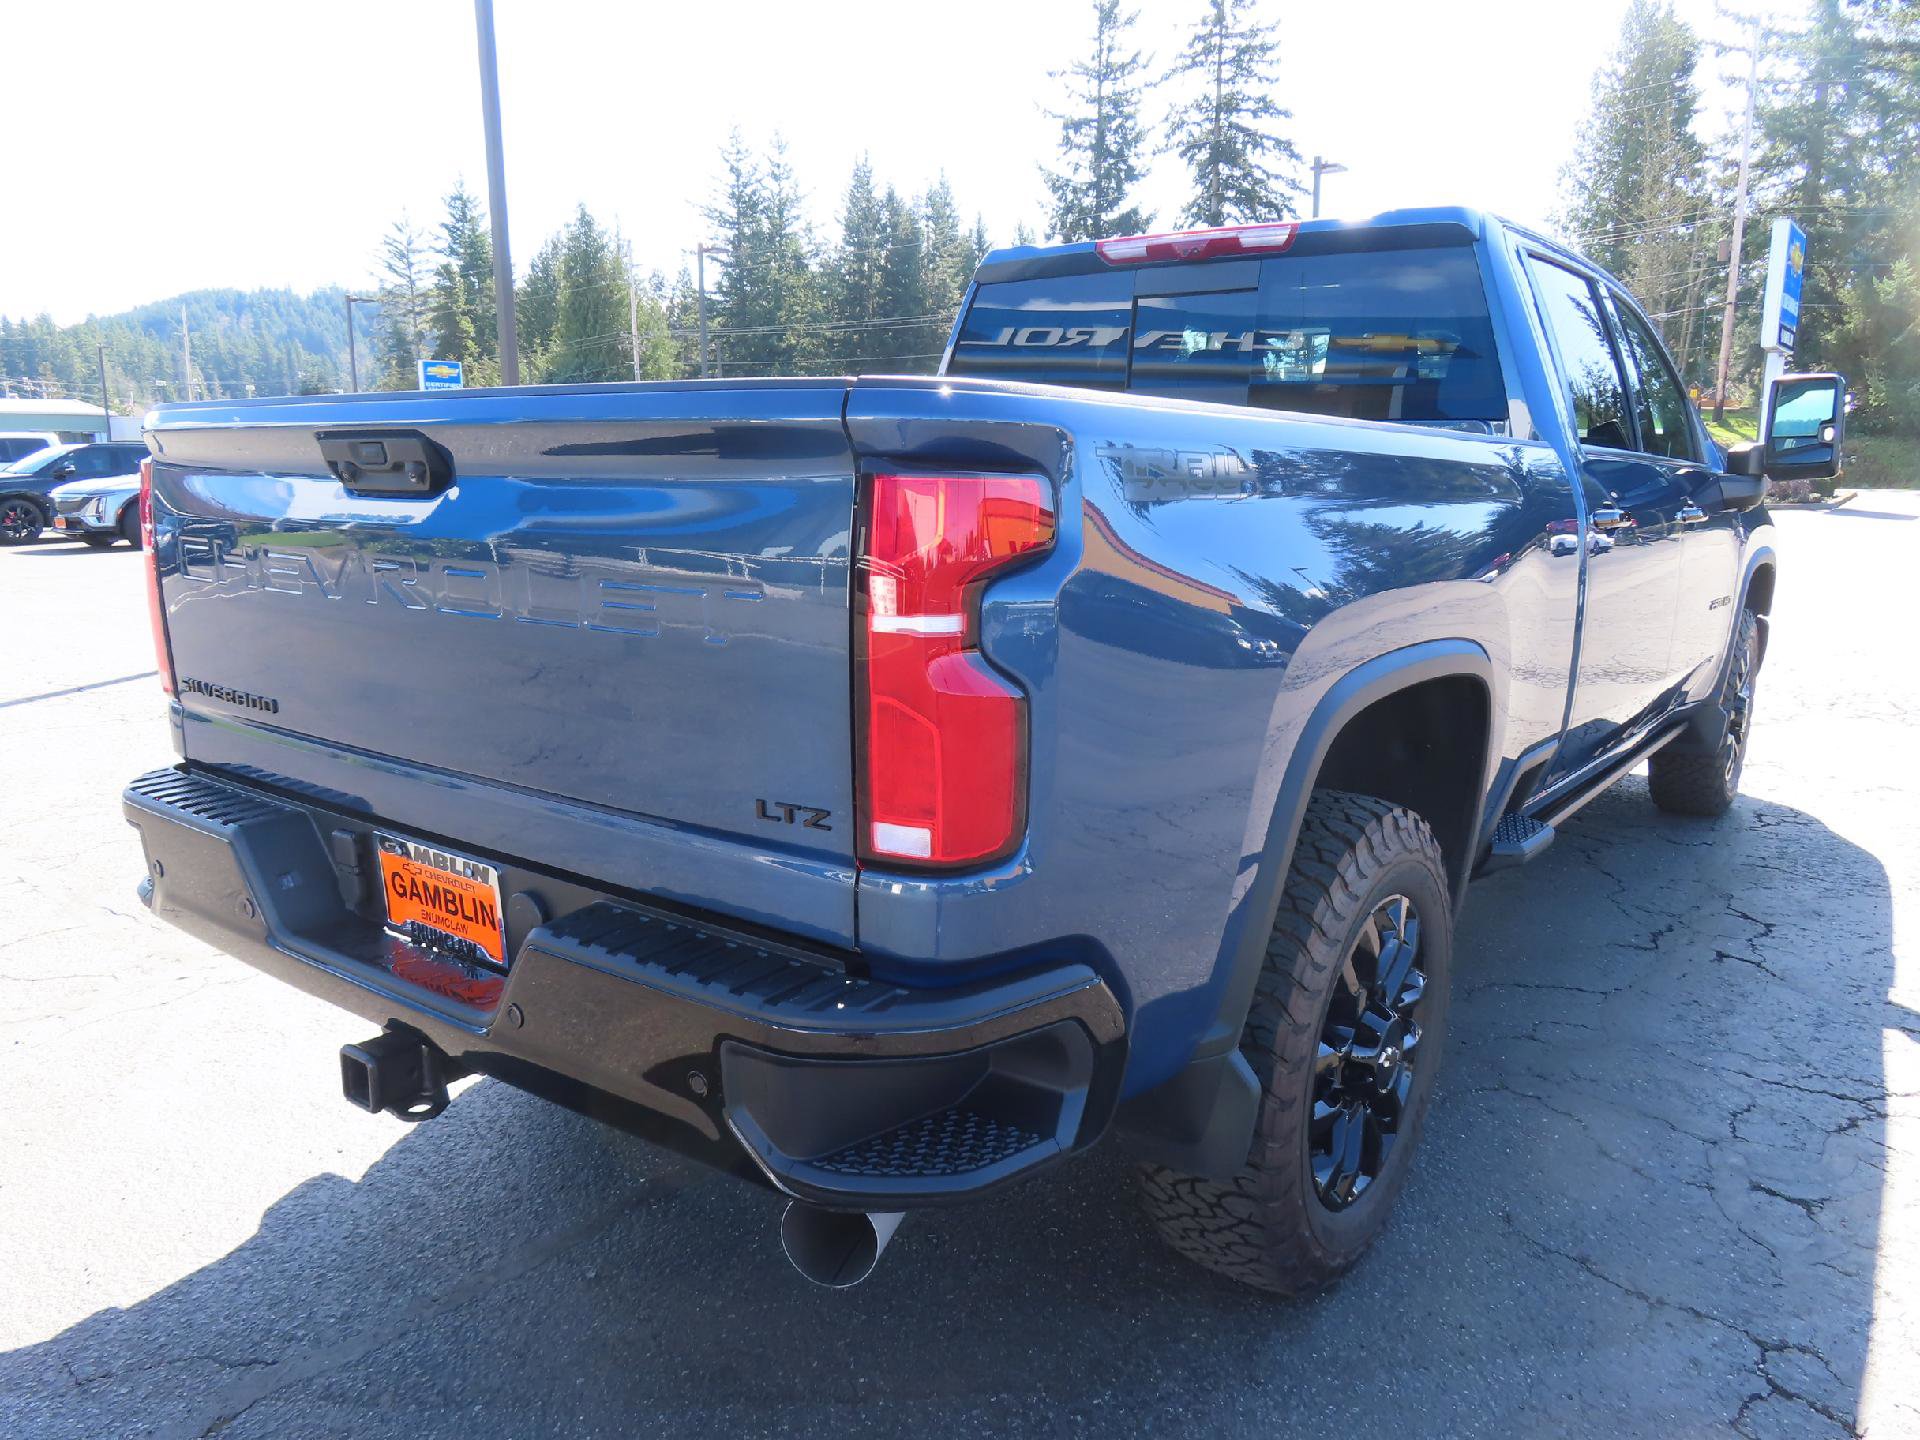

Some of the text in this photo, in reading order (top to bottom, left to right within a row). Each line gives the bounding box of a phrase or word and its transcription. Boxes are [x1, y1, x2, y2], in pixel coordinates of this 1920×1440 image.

[178, 535, 764, 645] CHEVROLET
[756, 798, 832, 831] LTZ
[379, 837, 490, 885] GAMBLIN
[424, 869, 475, 893] CHEVROLET
[391, 871, 497, 931] GAMBLIN
